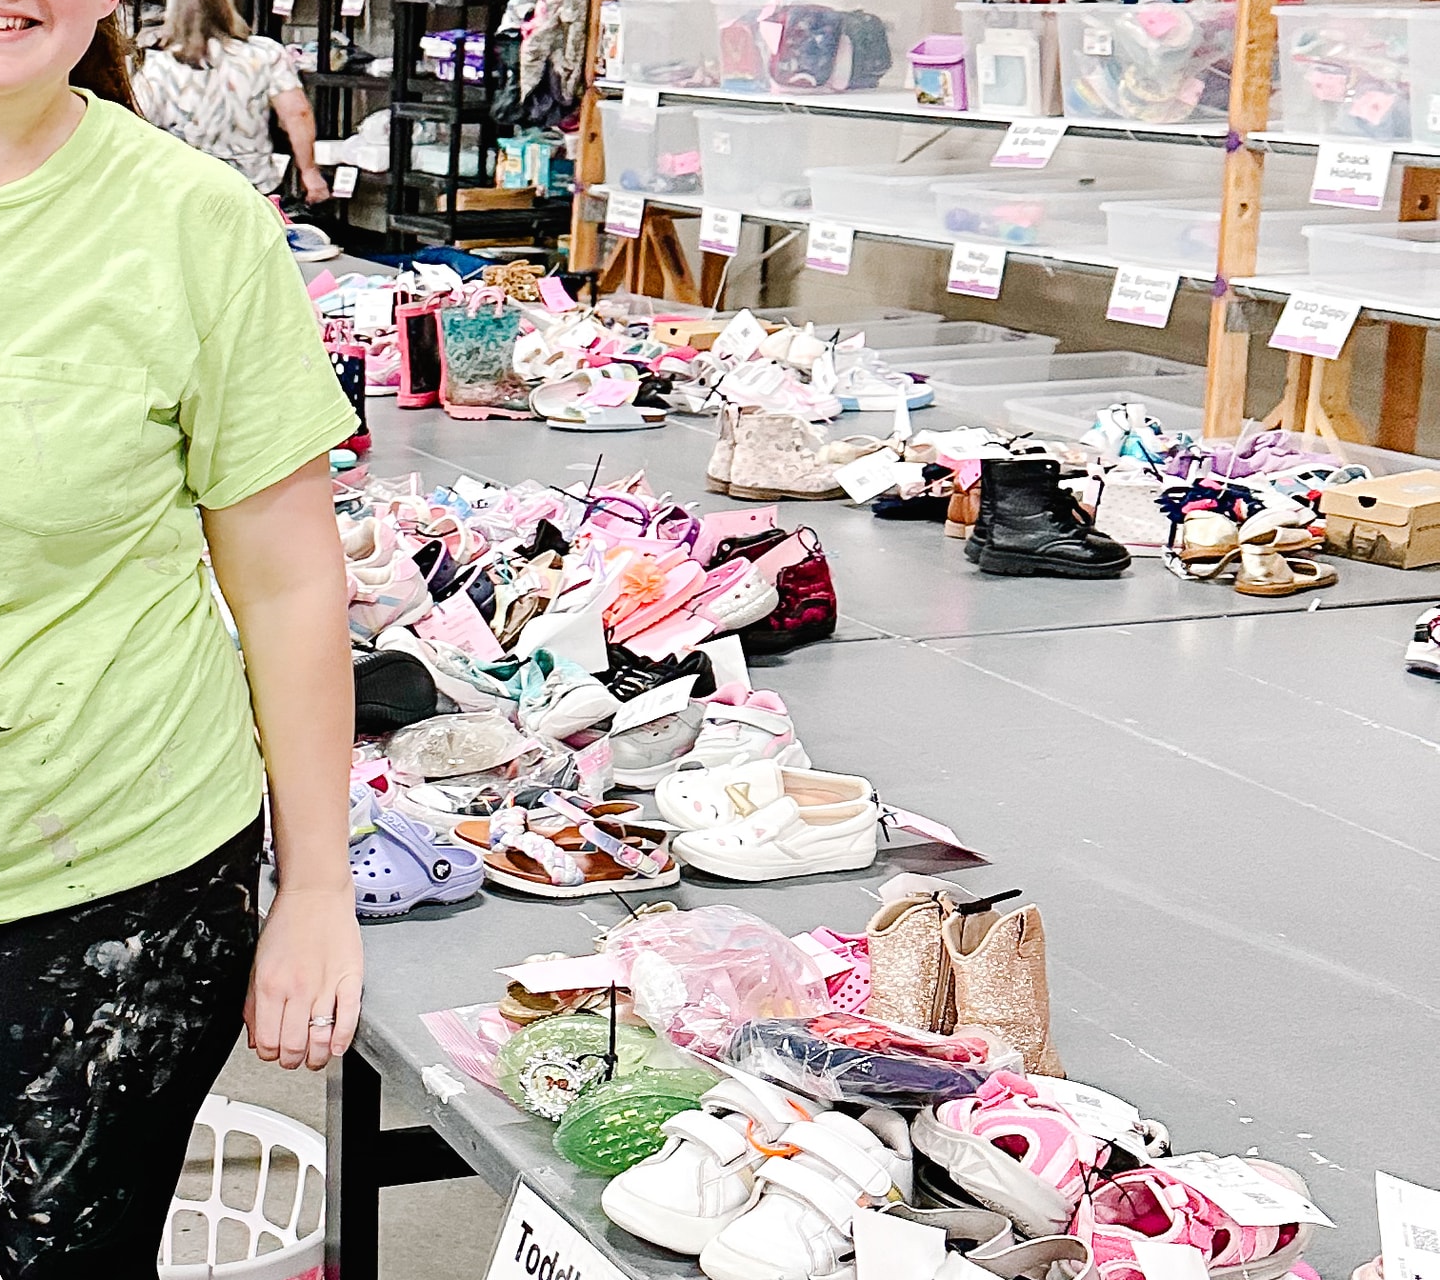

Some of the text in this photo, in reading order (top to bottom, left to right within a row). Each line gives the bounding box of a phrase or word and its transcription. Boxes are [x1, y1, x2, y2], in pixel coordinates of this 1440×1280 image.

[1336, 151, 1370, 165] Snack
[1329, 166, 1373, 181] Holders
[1319, 304, 1351, 322] Sippy
[1301, 315, 1329, 331] Cups
